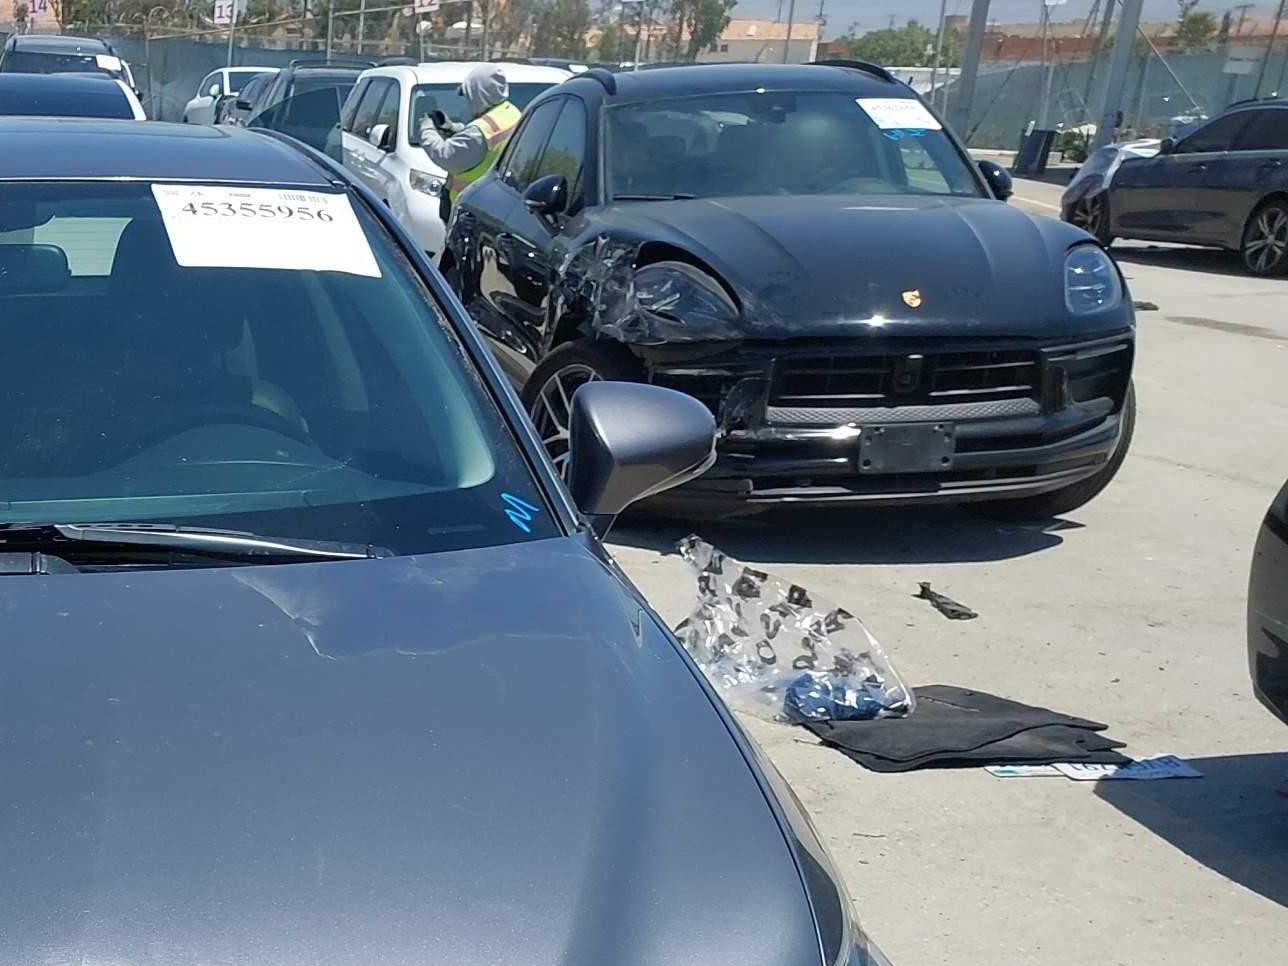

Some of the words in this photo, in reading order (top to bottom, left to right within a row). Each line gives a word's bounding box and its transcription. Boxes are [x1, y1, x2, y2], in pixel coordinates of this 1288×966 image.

[30, 0, 47, 13] 14
[215, 4, 233, 19] 13
[182, 202, 334, 223] 45355956
